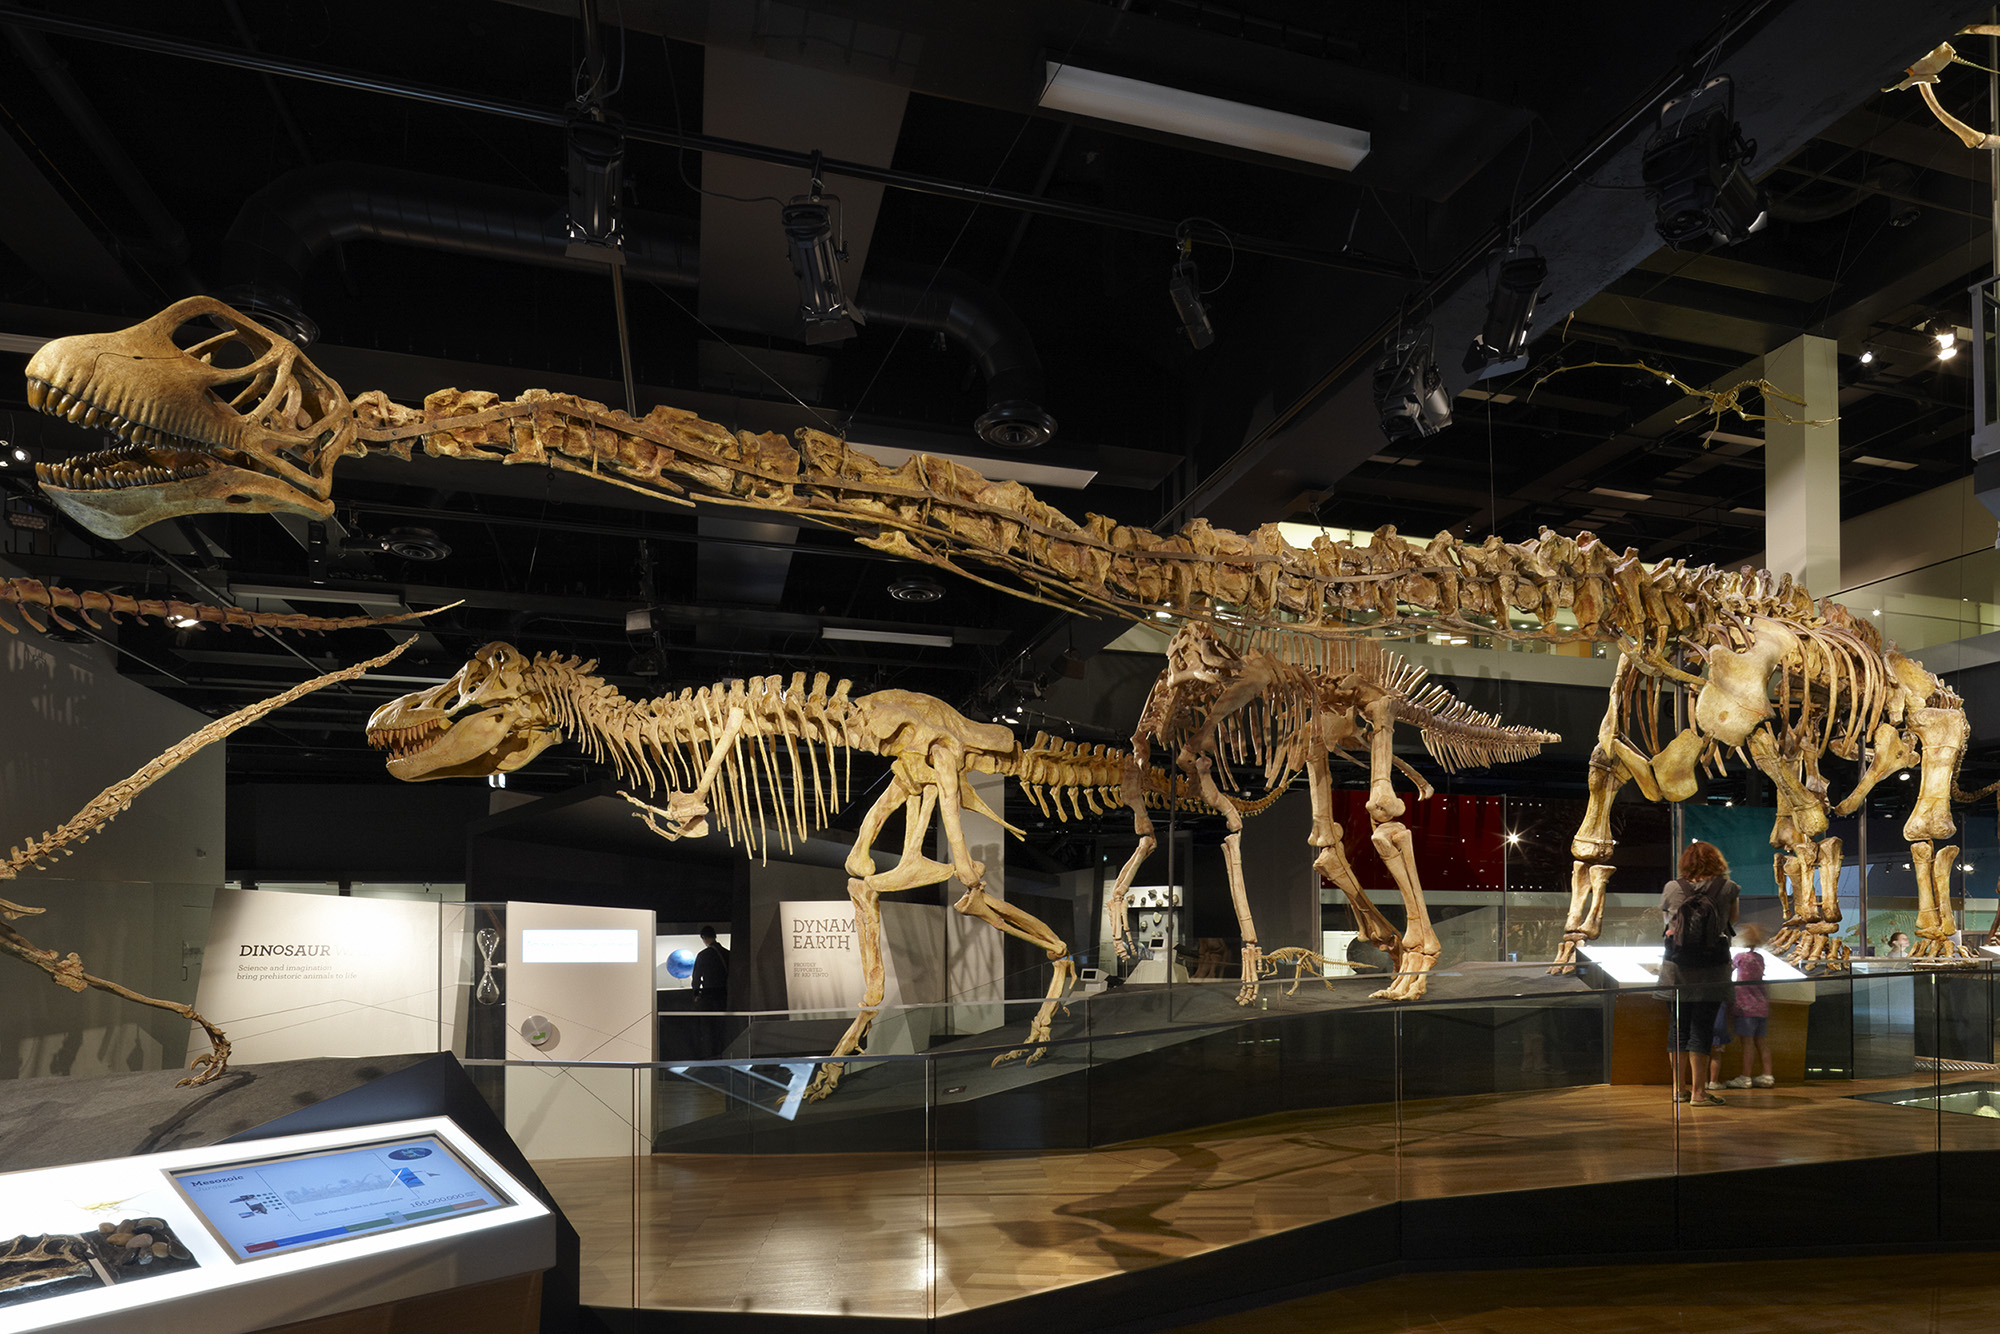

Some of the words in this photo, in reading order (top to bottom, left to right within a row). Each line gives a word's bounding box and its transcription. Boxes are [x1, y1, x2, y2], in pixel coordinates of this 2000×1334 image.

[793, 918, 857, 933] DYNAM
[793, 935, 850, 950] EARTH
[239, 944, 331, 957] DINOSAUR
[286, 964, 332, 973] imagination
[236, 973, 258, 981] bring
[260, 973, 302, 981] prehistoric
[345, 972, 357, 980] life
[191, 1175, 244, 1187] Mesozoic
